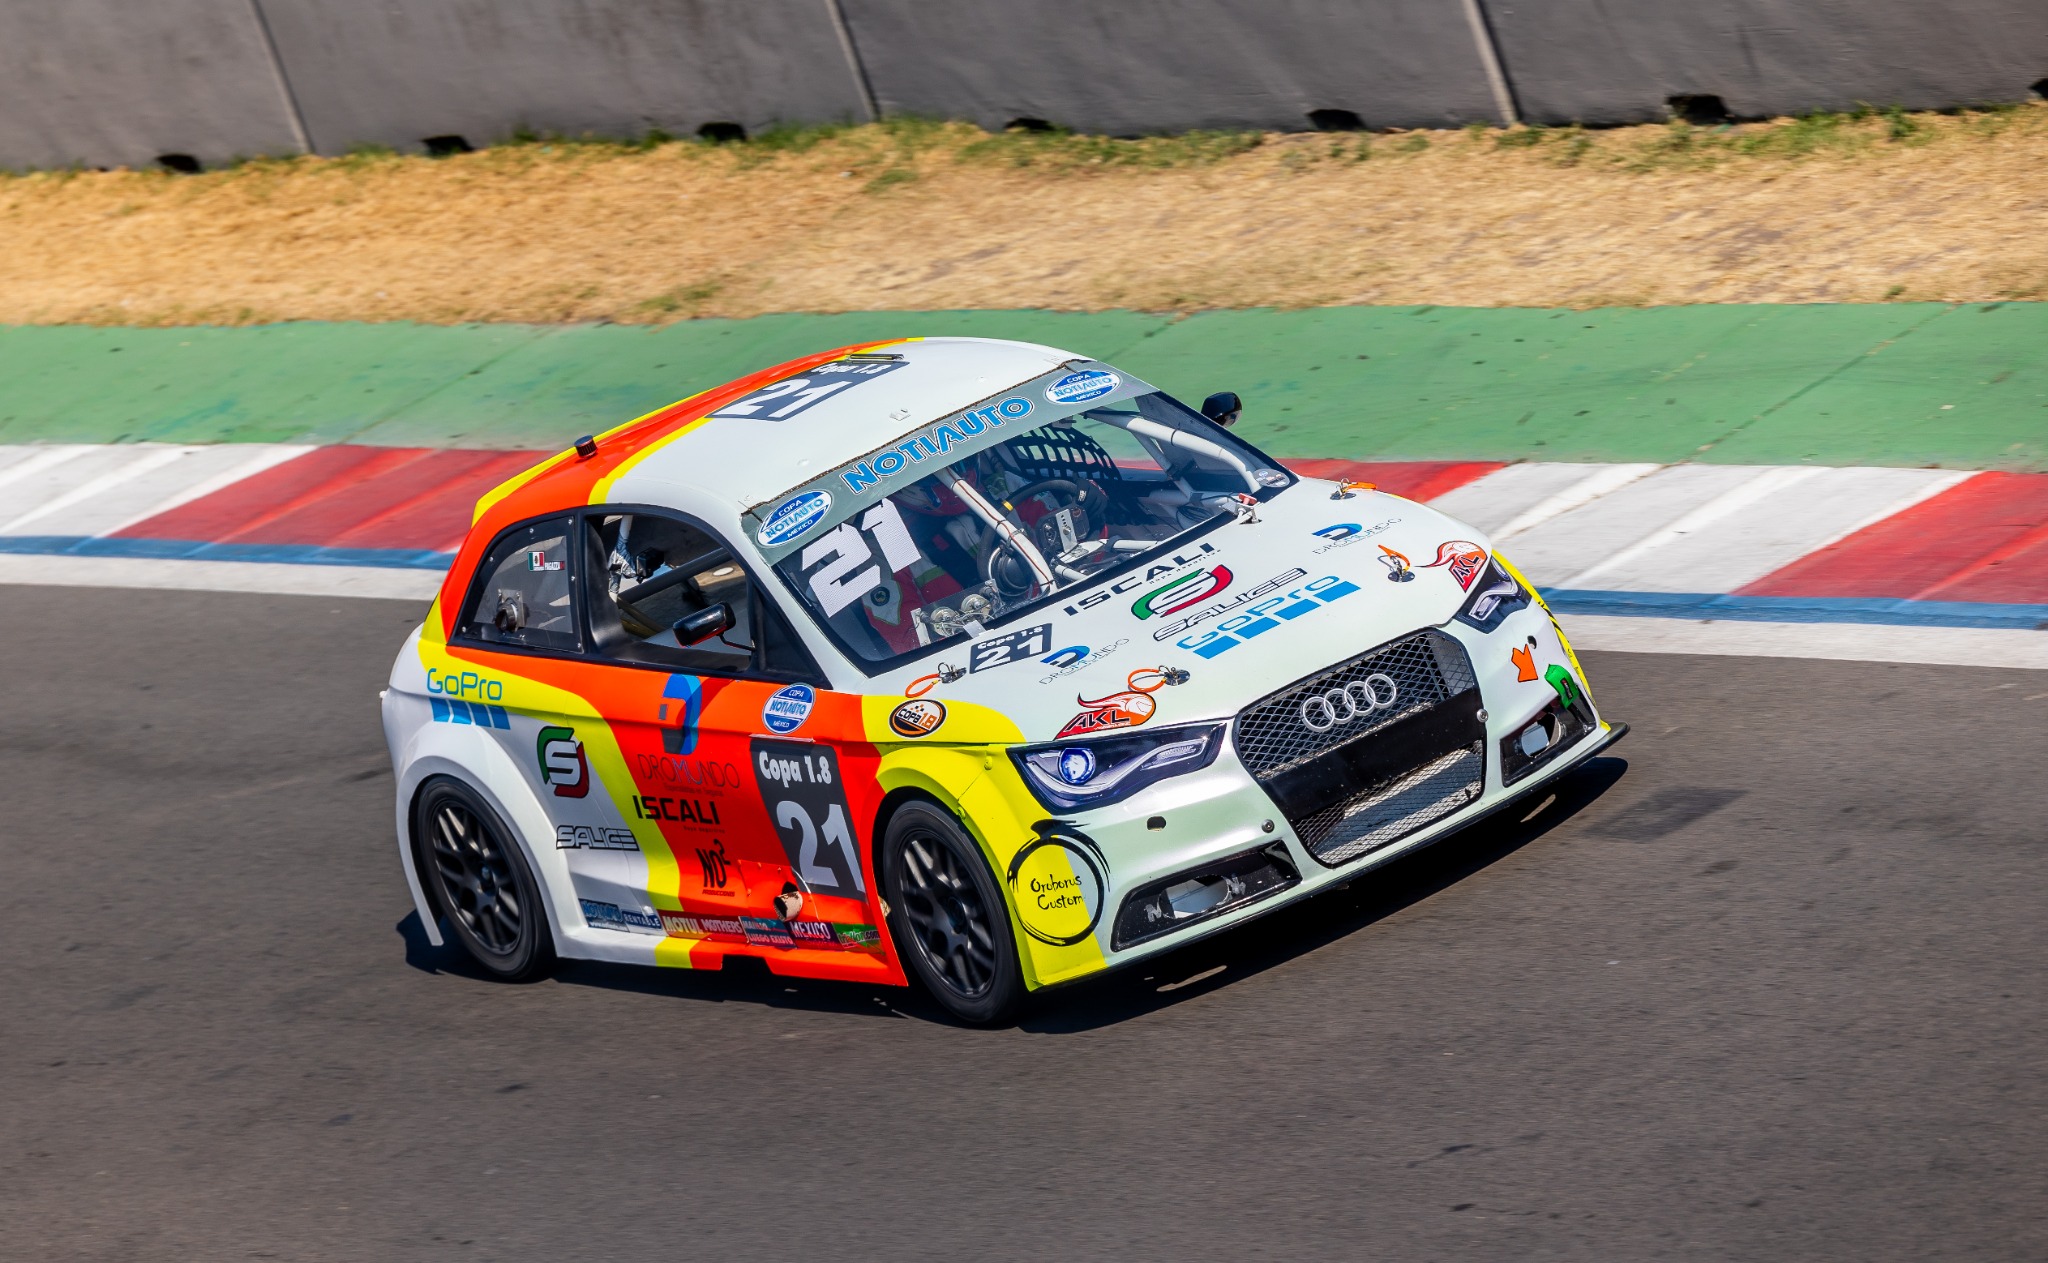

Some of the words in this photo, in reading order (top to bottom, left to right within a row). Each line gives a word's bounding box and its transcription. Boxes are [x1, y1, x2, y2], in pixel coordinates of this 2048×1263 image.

[1054, 377, 1112, 397] NOTIAUTO
[1066, 373, 1091, 384] COPA
[711, 378, 853, 418] 21
[840, 397, 1034, 494] NOTIAUTO
[765, 499, 824, 538] NOTIAUTO
[778, 499, 803, 517] COPA
[802, 498, 922, 618] 21
[1452, 556, 1480, 585] AKL
[1063, 542, 1215, 616] ISCALI
[1153, 567, 1308, 642] SALICE
[1176, 575, 1341, 650] GoPro
[974, 634, 1044, 671] 21
[977, 634, 1015, 650] Copa
[1020, 626, 1044, 637] 1.8
[1039, 638, 1130, 685] DROMUNDO
[427, 668, 503, 700] GoPro
[788, 689, 805, 698] COPA
[769, 699, 808, 717] NOTIAUTO
[1063, 709, 1131, 733] AKL
[637, 754, 740, 789] DROMUNDO
[759, 750, 803, 788] Copa
[803, 755, 832, 784] 1.8
[632, 795, 721, 825] ISCALI
[556, 825, 640, 851] SALICE
[776, 800, 866, 894] 21
[1037, 893, 1085, 910] Custom
[623, 912, 661, 928] RENTABLE
[662, 915, 703, 935] MOTUL
[701, 917, 744, 934] MOTHERS
[789, 920, 832, 941] MEXICO
